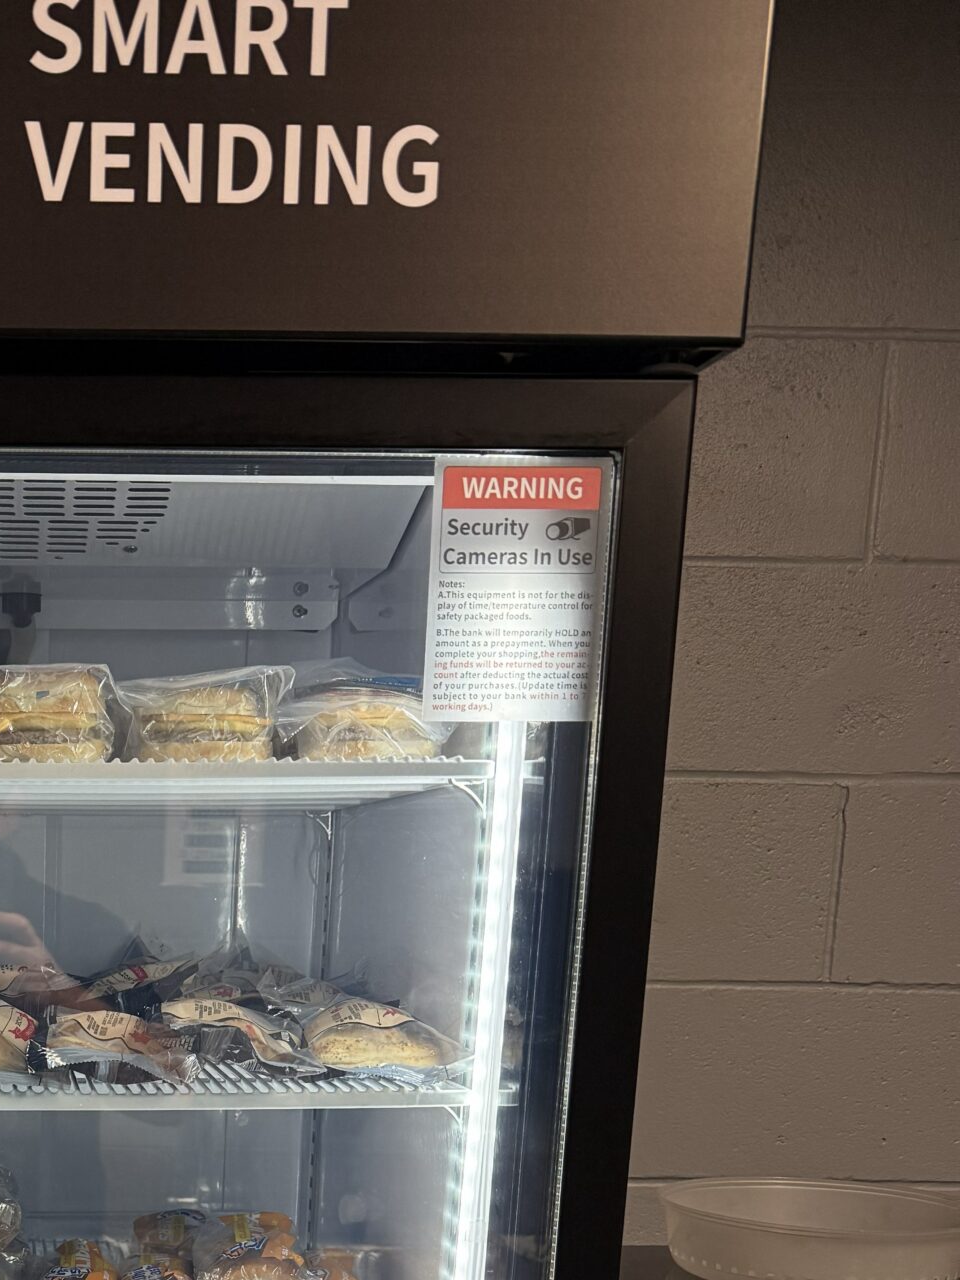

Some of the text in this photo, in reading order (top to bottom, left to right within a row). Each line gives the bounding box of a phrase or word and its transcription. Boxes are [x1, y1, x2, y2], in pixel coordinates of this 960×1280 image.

[30, 0, 348, 76] SMART
[24, 121, 440, 207] VENDING
[463, 476, 583, 499] WARNING
[447, 518, 529, 540] Security
[443, 548, 593, 566] Cameras In Use
[439, 580, 465, 588] Notes:
[438, 590, 465, 599] A.This
[467, 591, 516, 600] equipment
[561, 591, 575, 599] the
[437, 601, 579, 611] play time/temperature control
[437, 612, 532, 622] safety packaged foods.
[436, 628, 579, 638] B.The bank will temporarily HOLD
[491, 640, 546, 649] prepayment.
[435, 650, 497, 660] complete your
[434, 661, 448, 670] ing
[449, 660, 473, 668] funds
[476, 660, 491, 668] will
[556, 662, 575, 670] your
[460, 671, 481, 679] after
[483, 671, 525, 680] deducting
[527, 671, 541, 679] the
[543, 671, 570, 679] actual
[445, 681, 578, 691] your time
[432, 692, 559, 701] subject your bank within
[432, 702, 466, 712] working
